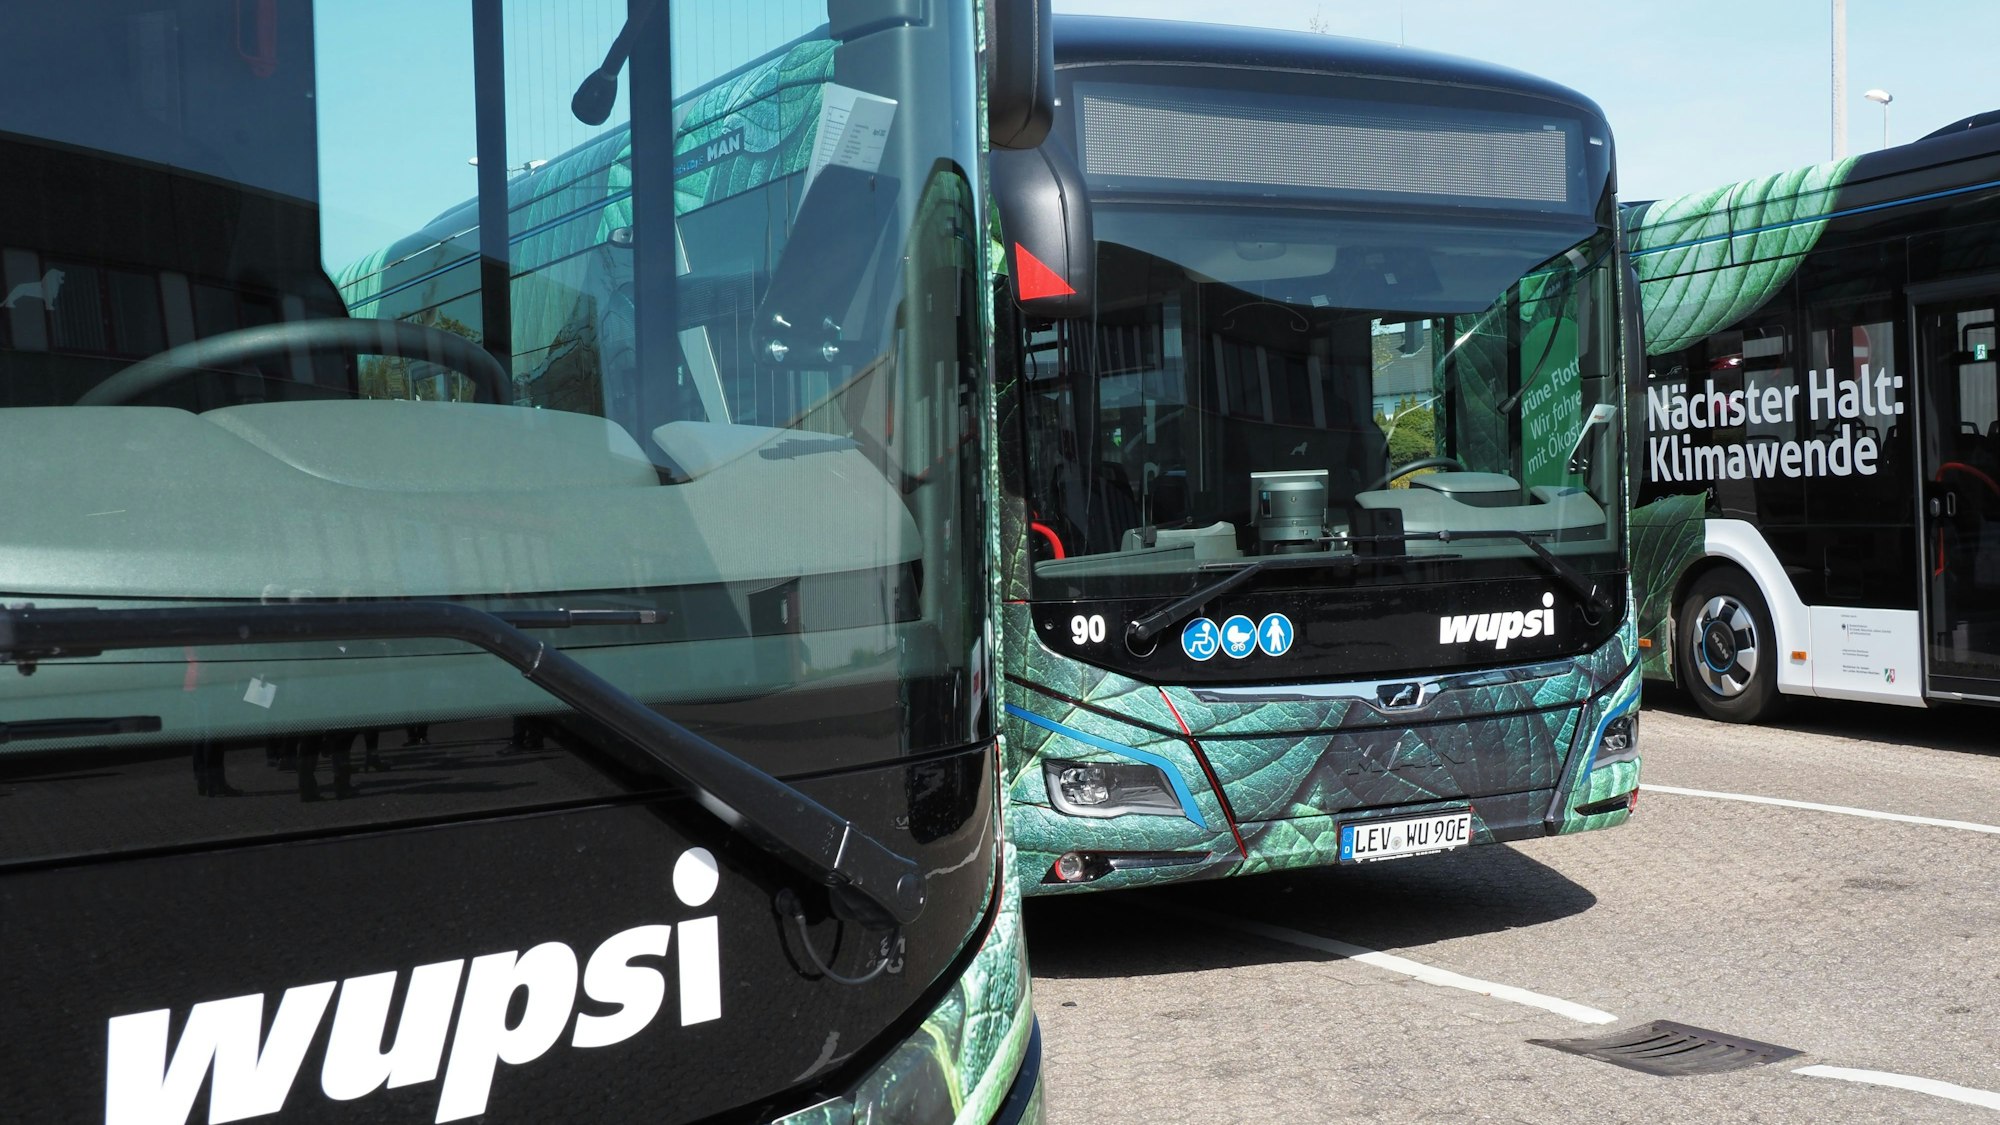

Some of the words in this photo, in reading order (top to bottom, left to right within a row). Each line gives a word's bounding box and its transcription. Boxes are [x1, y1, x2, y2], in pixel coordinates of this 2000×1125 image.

[706, 133, 741, 162] MAN
[1647, 380, 1803, 432] Nächster
[1808, 363, 1905, 421] Halt:
[1527, 446, 1548, 475] mit
[1548, 420, 1583, 458] Ökost
[1530, 412, 1551, 440] Wir
[1649, 423, 1879, 482] Klimawende
[1070, 614, 1107, 645] 90
[1439, 591, 1556, 650] wupsi
[1711, 632, 1730, 660] MAN
[1344, 845, 1350, 854] D
[1355, 826, 1392, 854] LEV
[1406, 822, 1430, 848] WU
[1434, 817, 1469, 844] 90E
[105, 846, 722, 1125] wupsi
